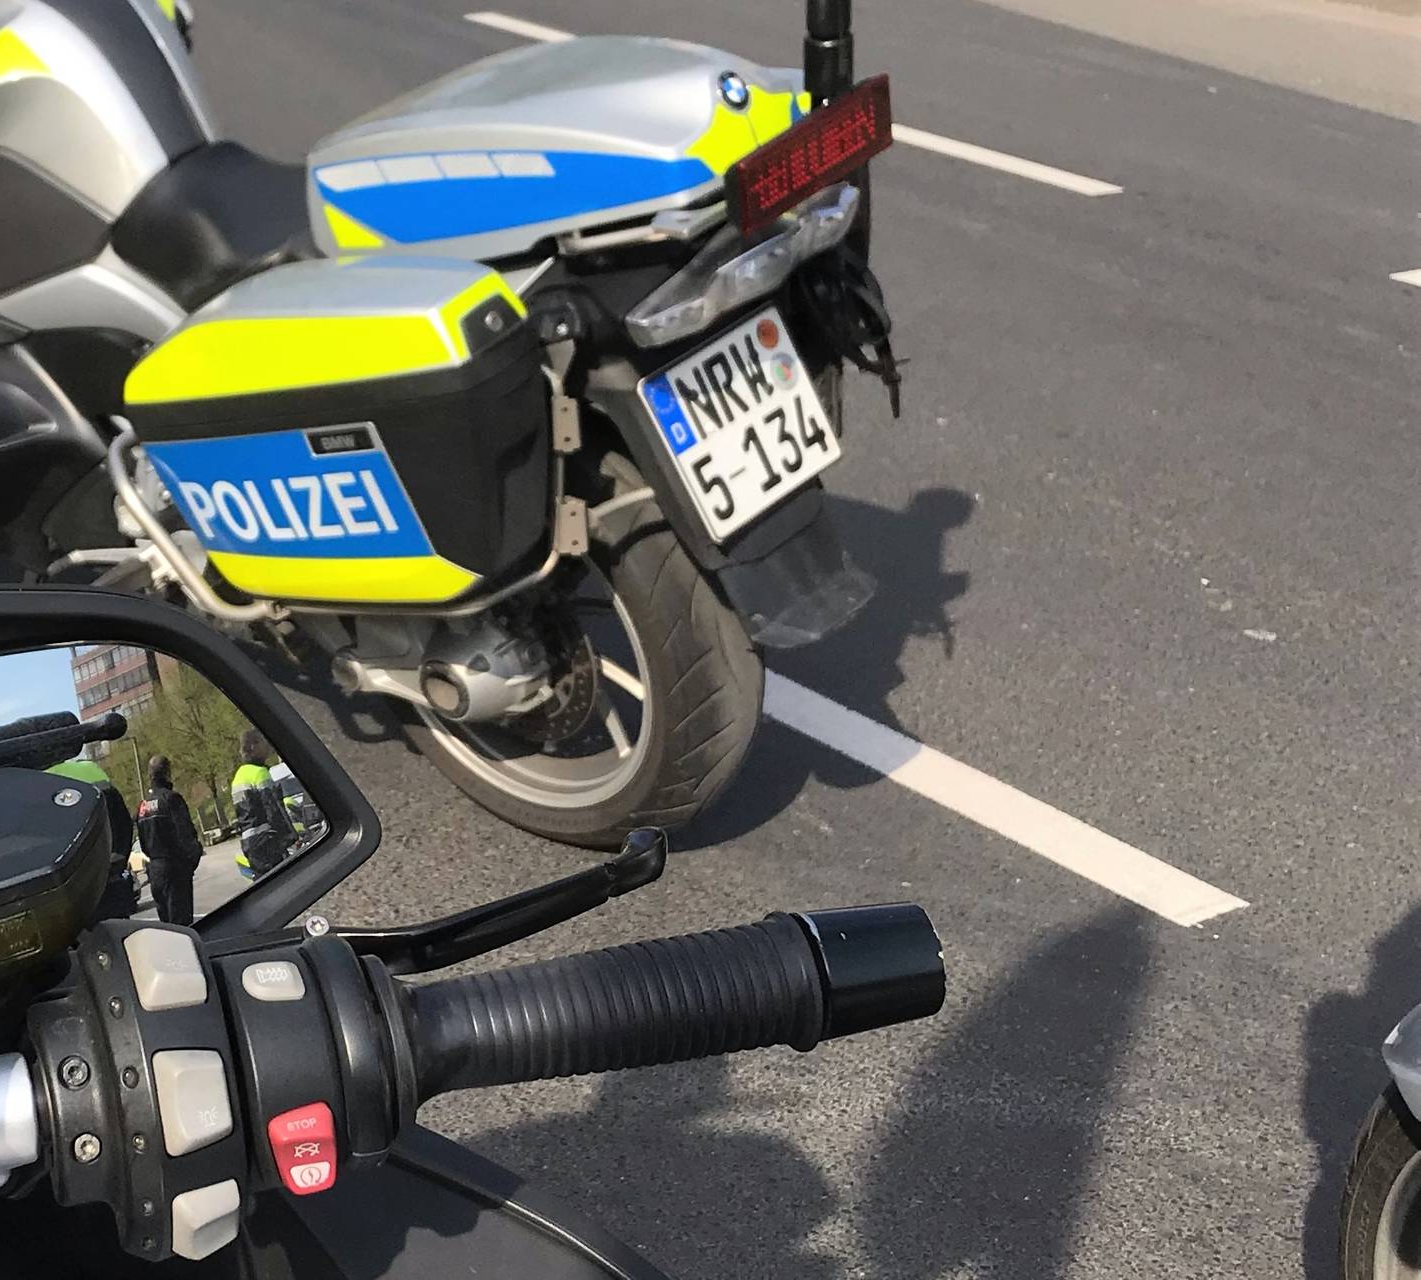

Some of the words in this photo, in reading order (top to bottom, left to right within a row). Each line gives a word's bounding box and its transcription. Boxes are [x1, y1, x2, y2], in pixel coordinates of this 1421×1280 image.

[675, 333, 774, 440] NRW
[320, 434, 356, 450] BMW
[670, 421, 687, 444] D
[691, 395, 829, 521] 5-134
[178, 469, 400, 543] POLIZEI
[287, 1117, 316, 1131] STOP
